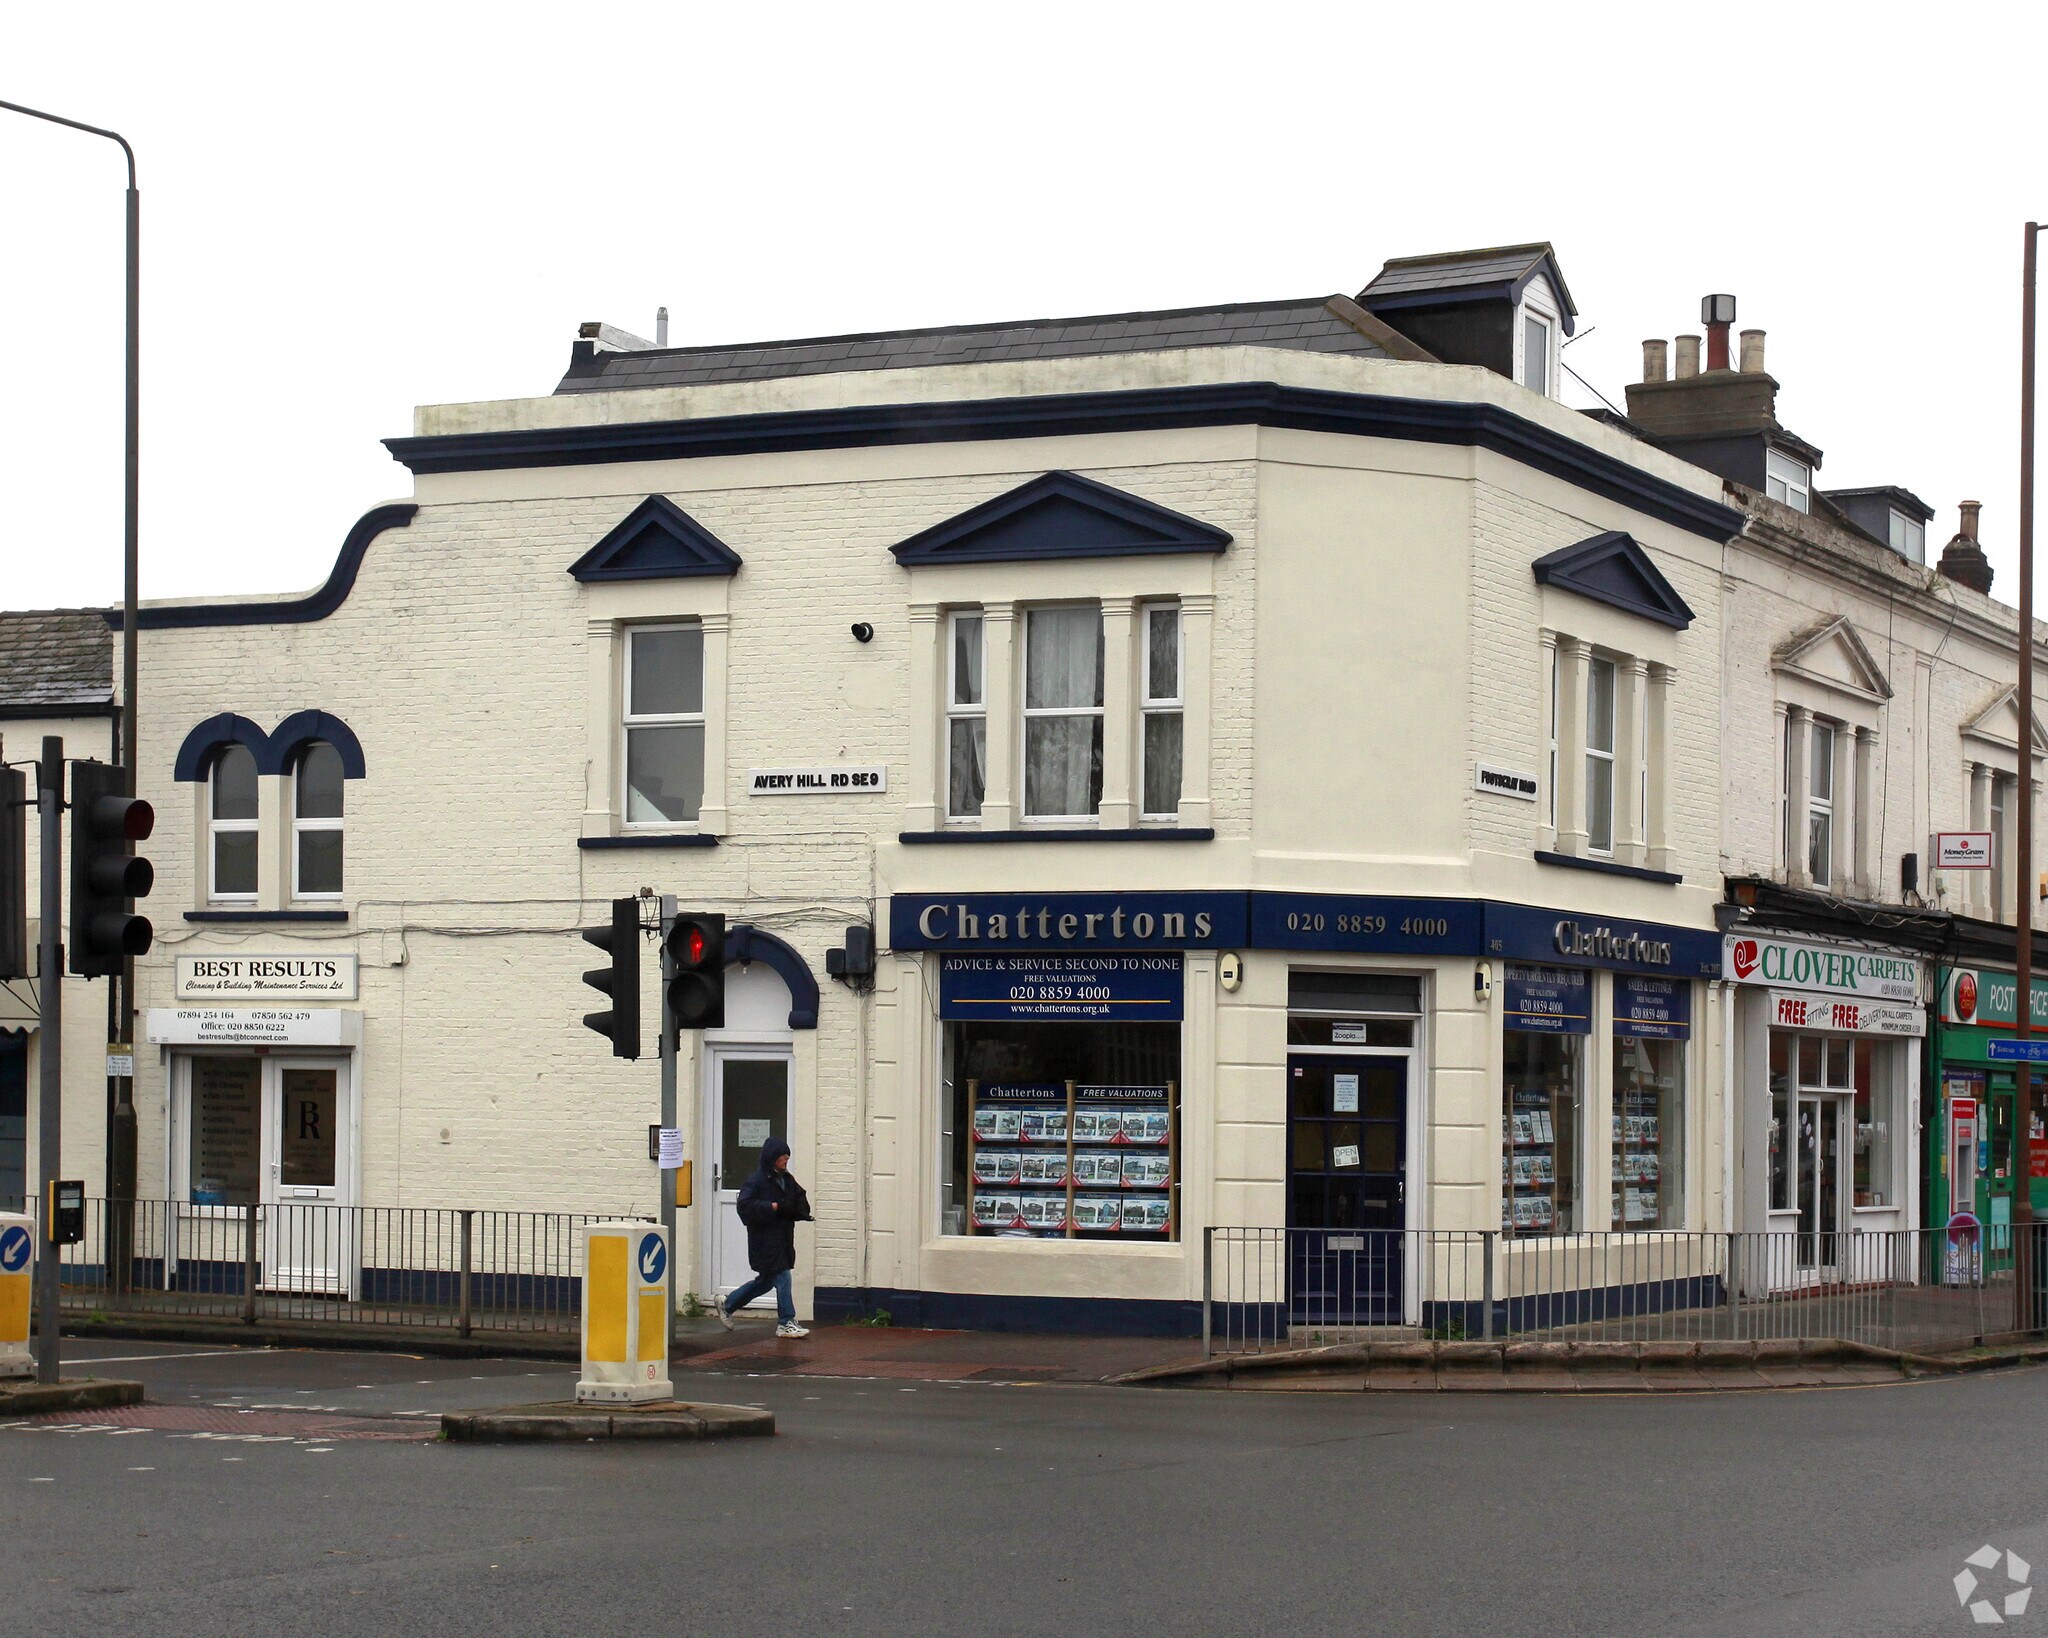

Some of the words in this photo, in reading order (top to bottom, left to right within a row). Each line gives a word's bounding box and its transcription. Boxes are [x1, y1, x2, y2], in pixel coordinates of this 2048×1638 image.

[754, 775, 793, 788] AVERY
[797, 774, 827, 787] HILL
[831, 773, 849, 787] RD
[852, 772, 879, 786] SE9
[1943, 848, 1984, 857] MoneyGram
[919, 904, 1212, 940] Chattertons
[1287, 912, 1325, 931] 020
[1337, 914, 1386, 934] 8859
[1400, 917, 1448, 936] 4000
[1553, 920, 1671, 965] Chattertons
[193, 961, 243, 977] BEST
[249, 961, 336, 977] RESULTS
[944, 958, 993, 971] ADVICE
[995, 959, 1006, 971] &
[1009, 959, 1062, 971] SERVICE
[1065, 959, 1118, 971] SECOND
[1121, 959, 1139, 971] TO
[1142, 958, 1180, 971] NONE
[1761, 944, 1858, 990] CLOVER
[1858, 955, 1915, 982] CARPETS
[1024, 974, 1044, 983] FREE
[1046, 974, 1097, 983] VALUATIONS
[1504, 967, 1526, 982] OPERTY
[1526, 970, 1556, 984] URGENTLY
[185, 979, 215, 991] Cleaning
[216, 979, 223, 989] &
[223, 979, 252, 992] Building
[253, 980, 298, 990] Maintenance
[299, 980, 328, 990] Services
[329, 980, 344, 990] Ltd
[1010, 986, 1036, 1000] 020
[1039, 986, 1072, 1000] 8859
[1076, 986, 1110, 1000] 4000
[1989, 983, 2016, 1013] POST
[1010, 1003, 1110, 1015] www.chattertons.org.uk
[1520, 999, 1532, 1012] 020
[1533, 1000, 1548, 1013] 8859
[1549, 1001, 1563, 1014] 4000
[177, 1011, 201, 1020] 07894
[203, 1011, 218, 1020] 254
[220, 1011, 235, 1020] 164
[251, 1012, 277, 1020] 07850
[278, 1012, 293, 1020] 562
[295, 1012, 311, 1021] 479
[1631, 1007, 1641, 1019] 020
[1642, 1008, 1655, 1020] 8859
[1656, 1009, 1669, 1021] 4000
[1778, 998, 1807, 1026] FREE
[1806, 1002, 1829, 1027] FITTING
[1832, 1003, 1859, 1030] FREE
[1858, 1006, 1882, 1030] DELIVERY
[1896, 1011, 1913, 1021] CARPETS
[201, 1022, 226, 1031] Office:
[227, 1022, 243, 1031] 020
[244, 1022, 264, 1031] 8850
[265, 1022, 285, 1032] 6222
[1881, 1022, 1899, 1031] MINIMUM
[197, 1033, 289, 1042] bestresults@btconnect.com
[990, 1086, 1055, 1098] Chattertons
[1083, 1089, 1105, 1097] FREE
[1107, 1089, 1164, 1099] VALUATIONS
[1334, 1147, 1357, 1158] OPEN
